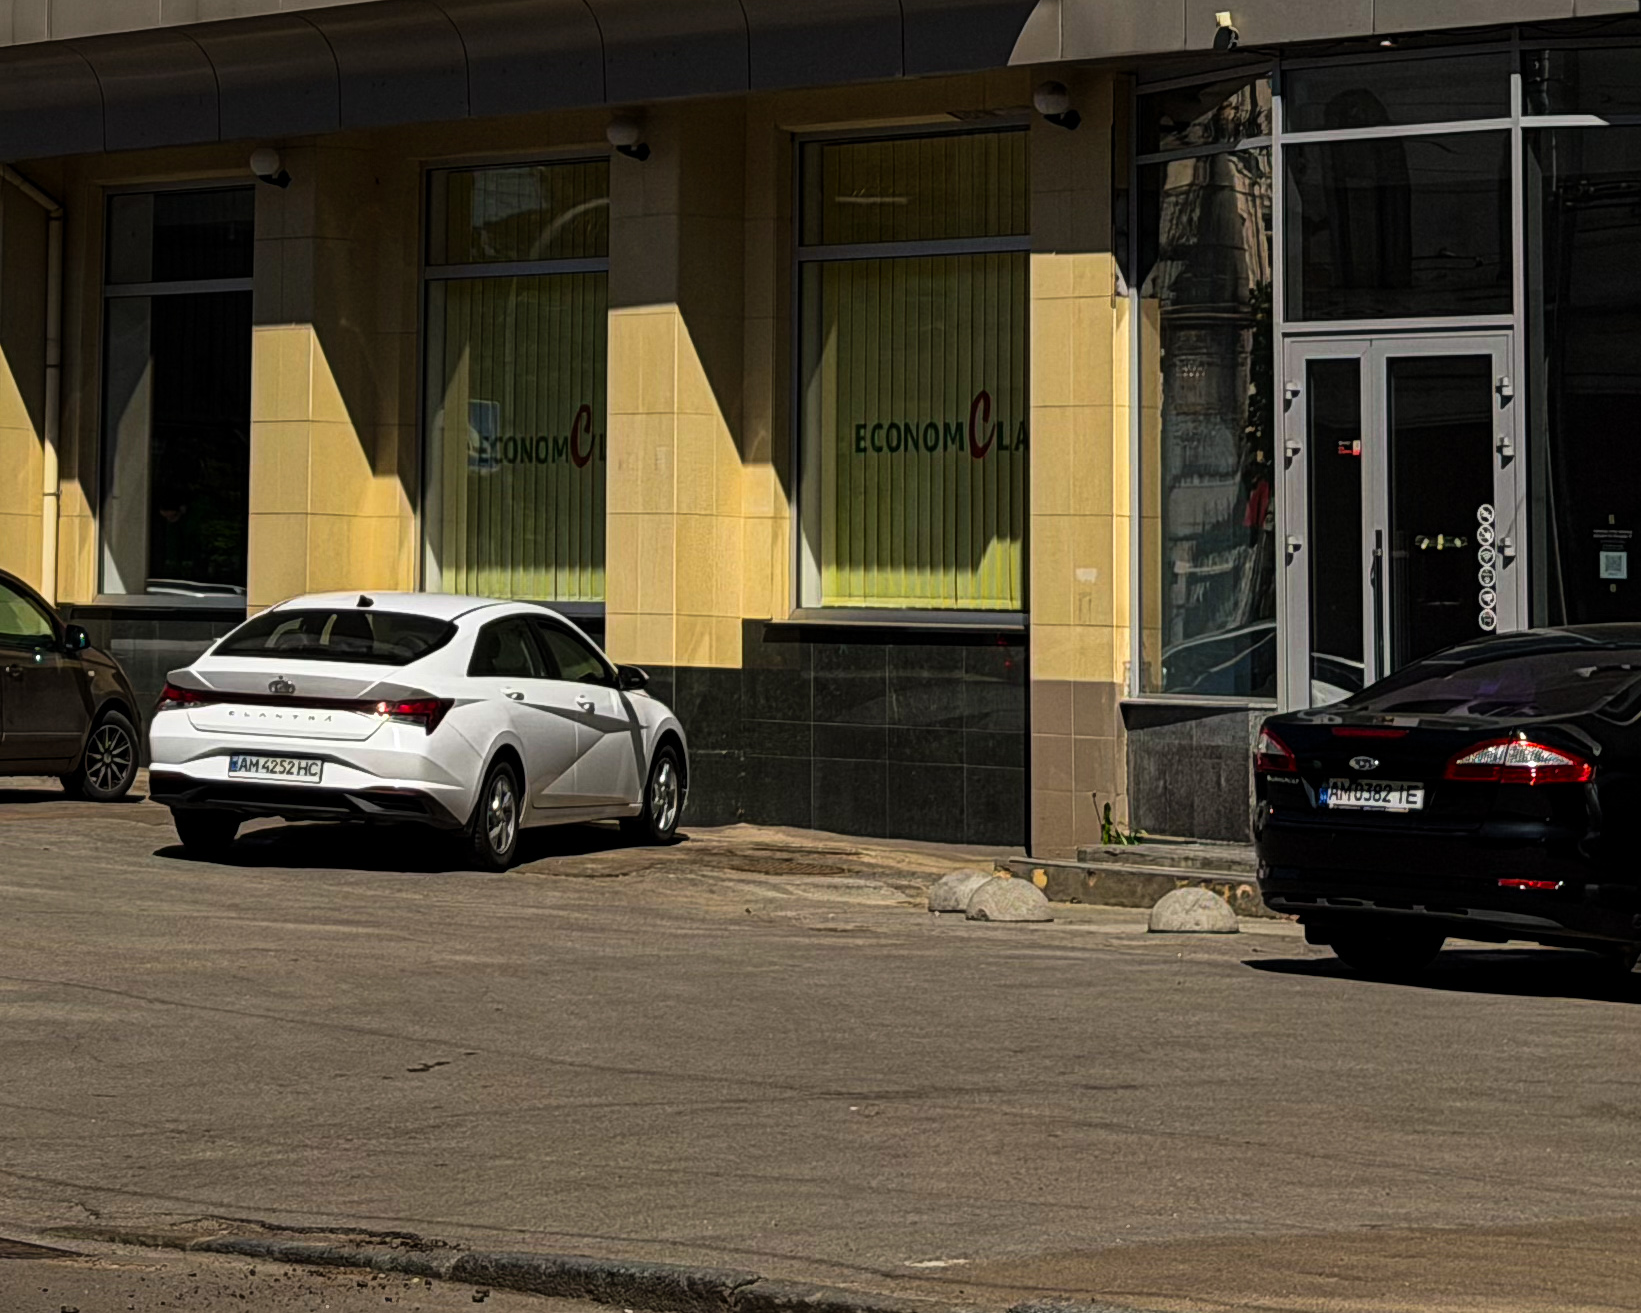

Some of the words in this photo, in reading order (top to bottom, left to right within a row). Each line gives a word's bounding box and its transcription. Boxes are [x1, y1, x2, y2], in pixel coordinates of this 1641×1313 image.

[239, 757, 259, 773] AM
[262, 759, 295, 775] 4252
[297, 761, 319, 777] HC
[1329, 781, 1350, 802] AM
